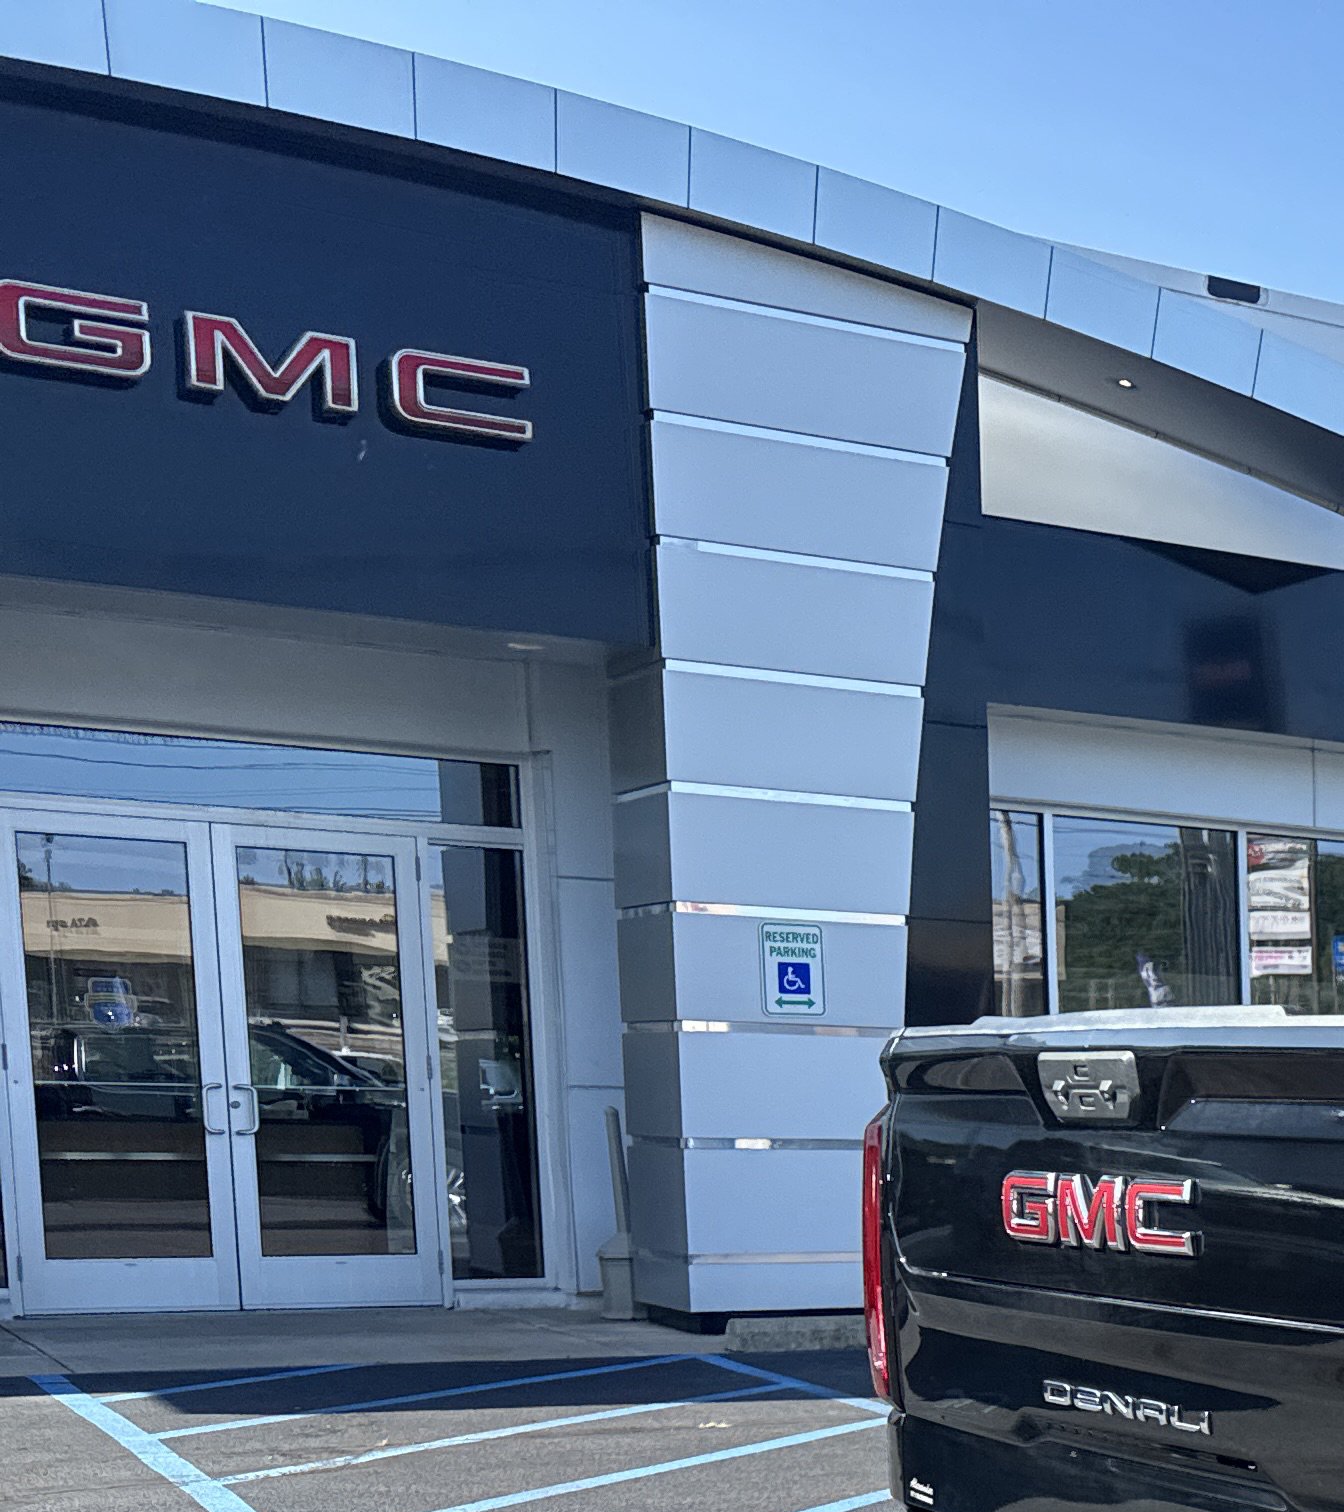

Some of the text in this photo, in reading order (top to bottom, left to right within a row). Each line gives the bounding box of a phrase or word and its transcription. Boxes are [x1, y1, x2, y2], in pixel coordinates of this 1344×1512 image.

[0, 279, 533, 441] GMC
[764, 931, 819, 944] RESERVED
[769, 946, 817, 958] PARKING
[1001, 1170, 1201, 1256] GMC
[1043, 1379, 1213, 1436] DENALI
